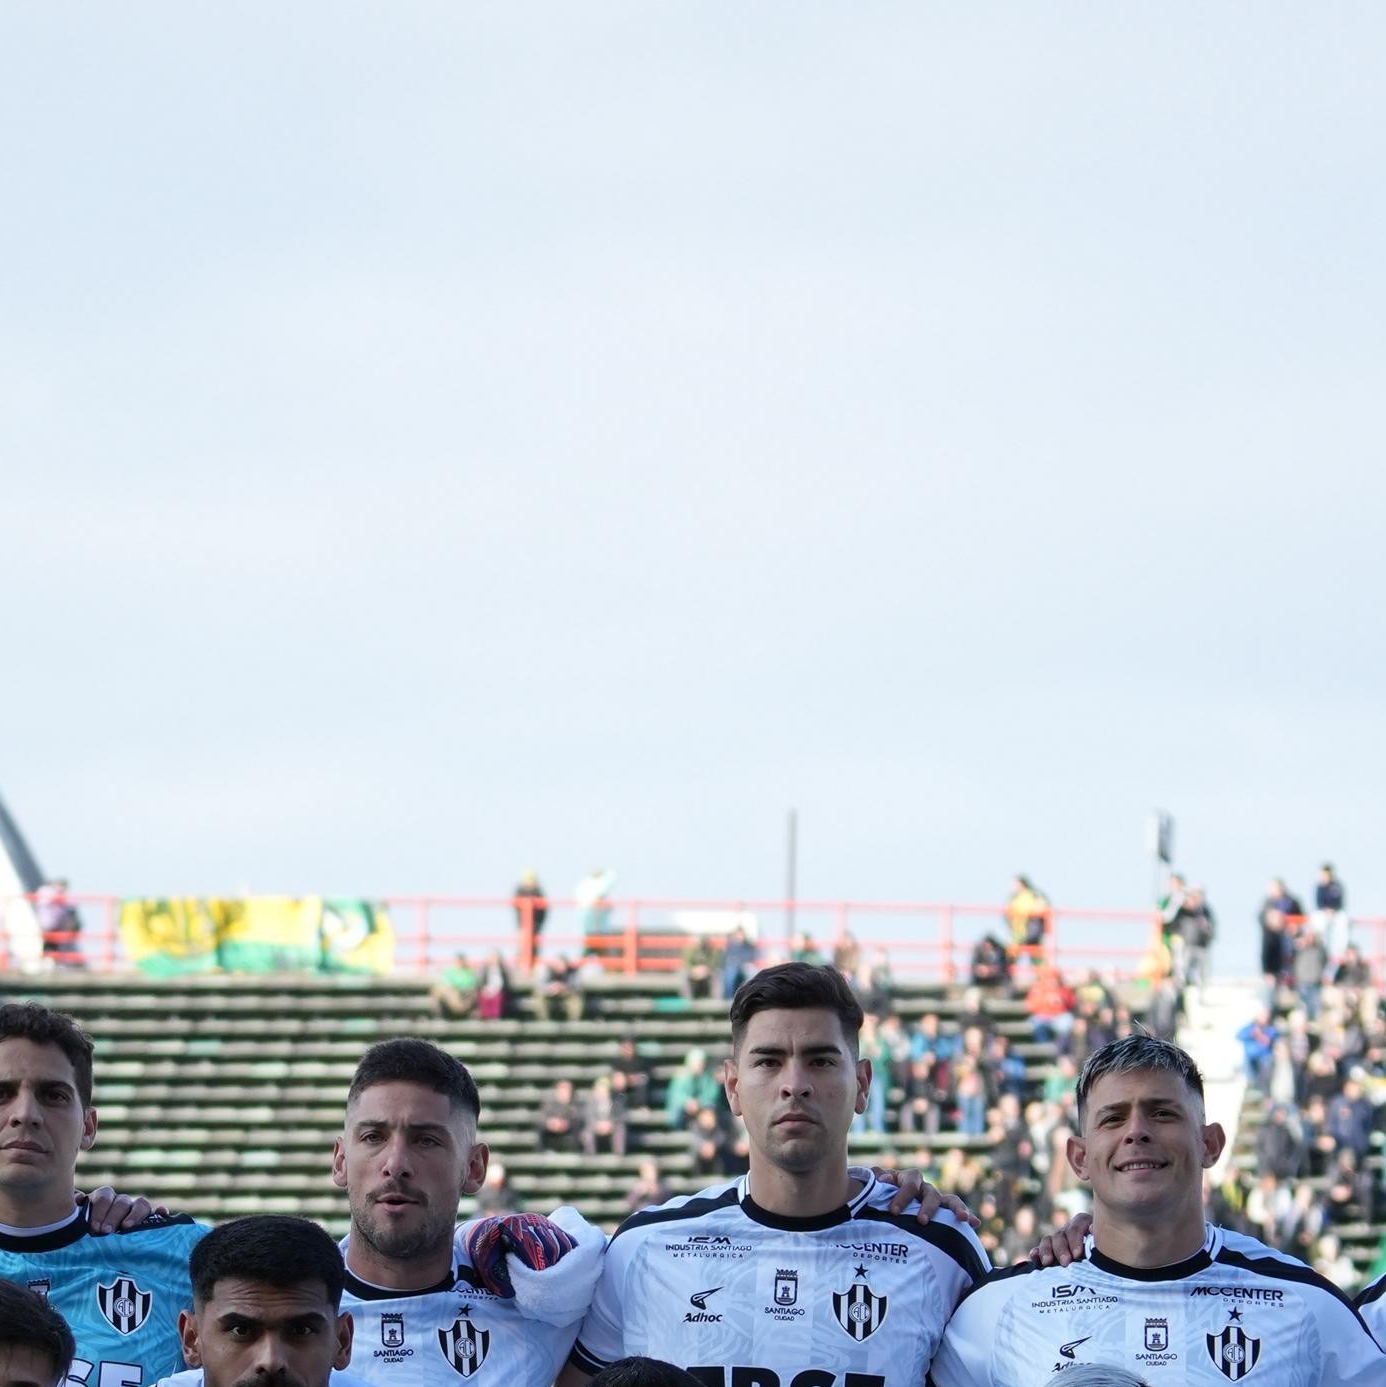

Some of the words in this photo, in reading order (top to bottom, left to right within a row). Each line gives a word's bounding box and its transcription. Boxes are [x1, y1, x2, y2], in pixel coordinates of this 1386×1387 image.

[1190, 1286, 1284, 1301] MCCENTER
[1031, 1300, 1075, 1308] INDUSTRIA
[1076, 1296, 1118, 1304] SANTIAGO
[764, 1307, 805, 1316] SANTIAGO
[683, 1312, 723, 1323] Adhoc
[373, 1349, 414, 1358] SANTIAGO
[1135, 1353, 1177, 1361] SANTIAGO
